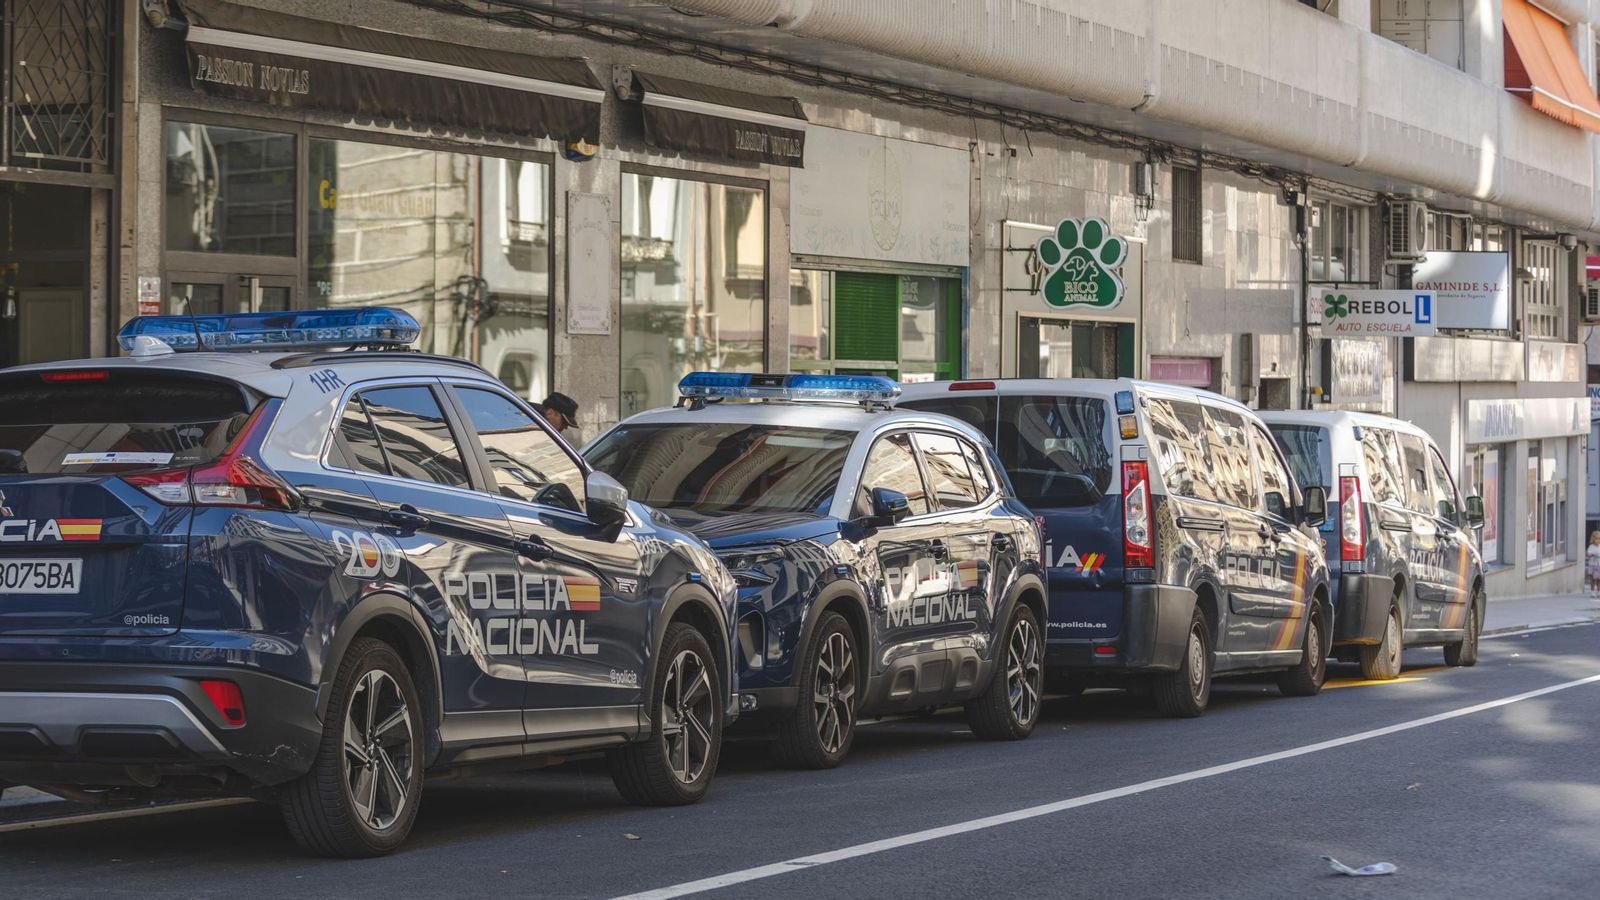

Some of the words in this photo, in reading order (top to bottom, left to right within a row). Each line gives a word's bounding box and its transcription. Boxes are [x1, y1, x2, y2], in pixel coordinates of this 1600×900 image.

[195, 54, 254, 87] PASSION
[260, 64, 310, 94] NOVIAS
[1063, 281, 1099, 293] BICO
[1415, 281, 1480, 292] GAMINIDE
[1063, 293, 1099, 302] ANIMAL
[1336, 322, 1362, 332] AUTO
[1366, 322, 1412, 332] ESCUELA
[886, 593, 977, 629] NACIONAL
[123, 614, 170, 626] @policia
[446, 617, 599, 656] NACIONAL
